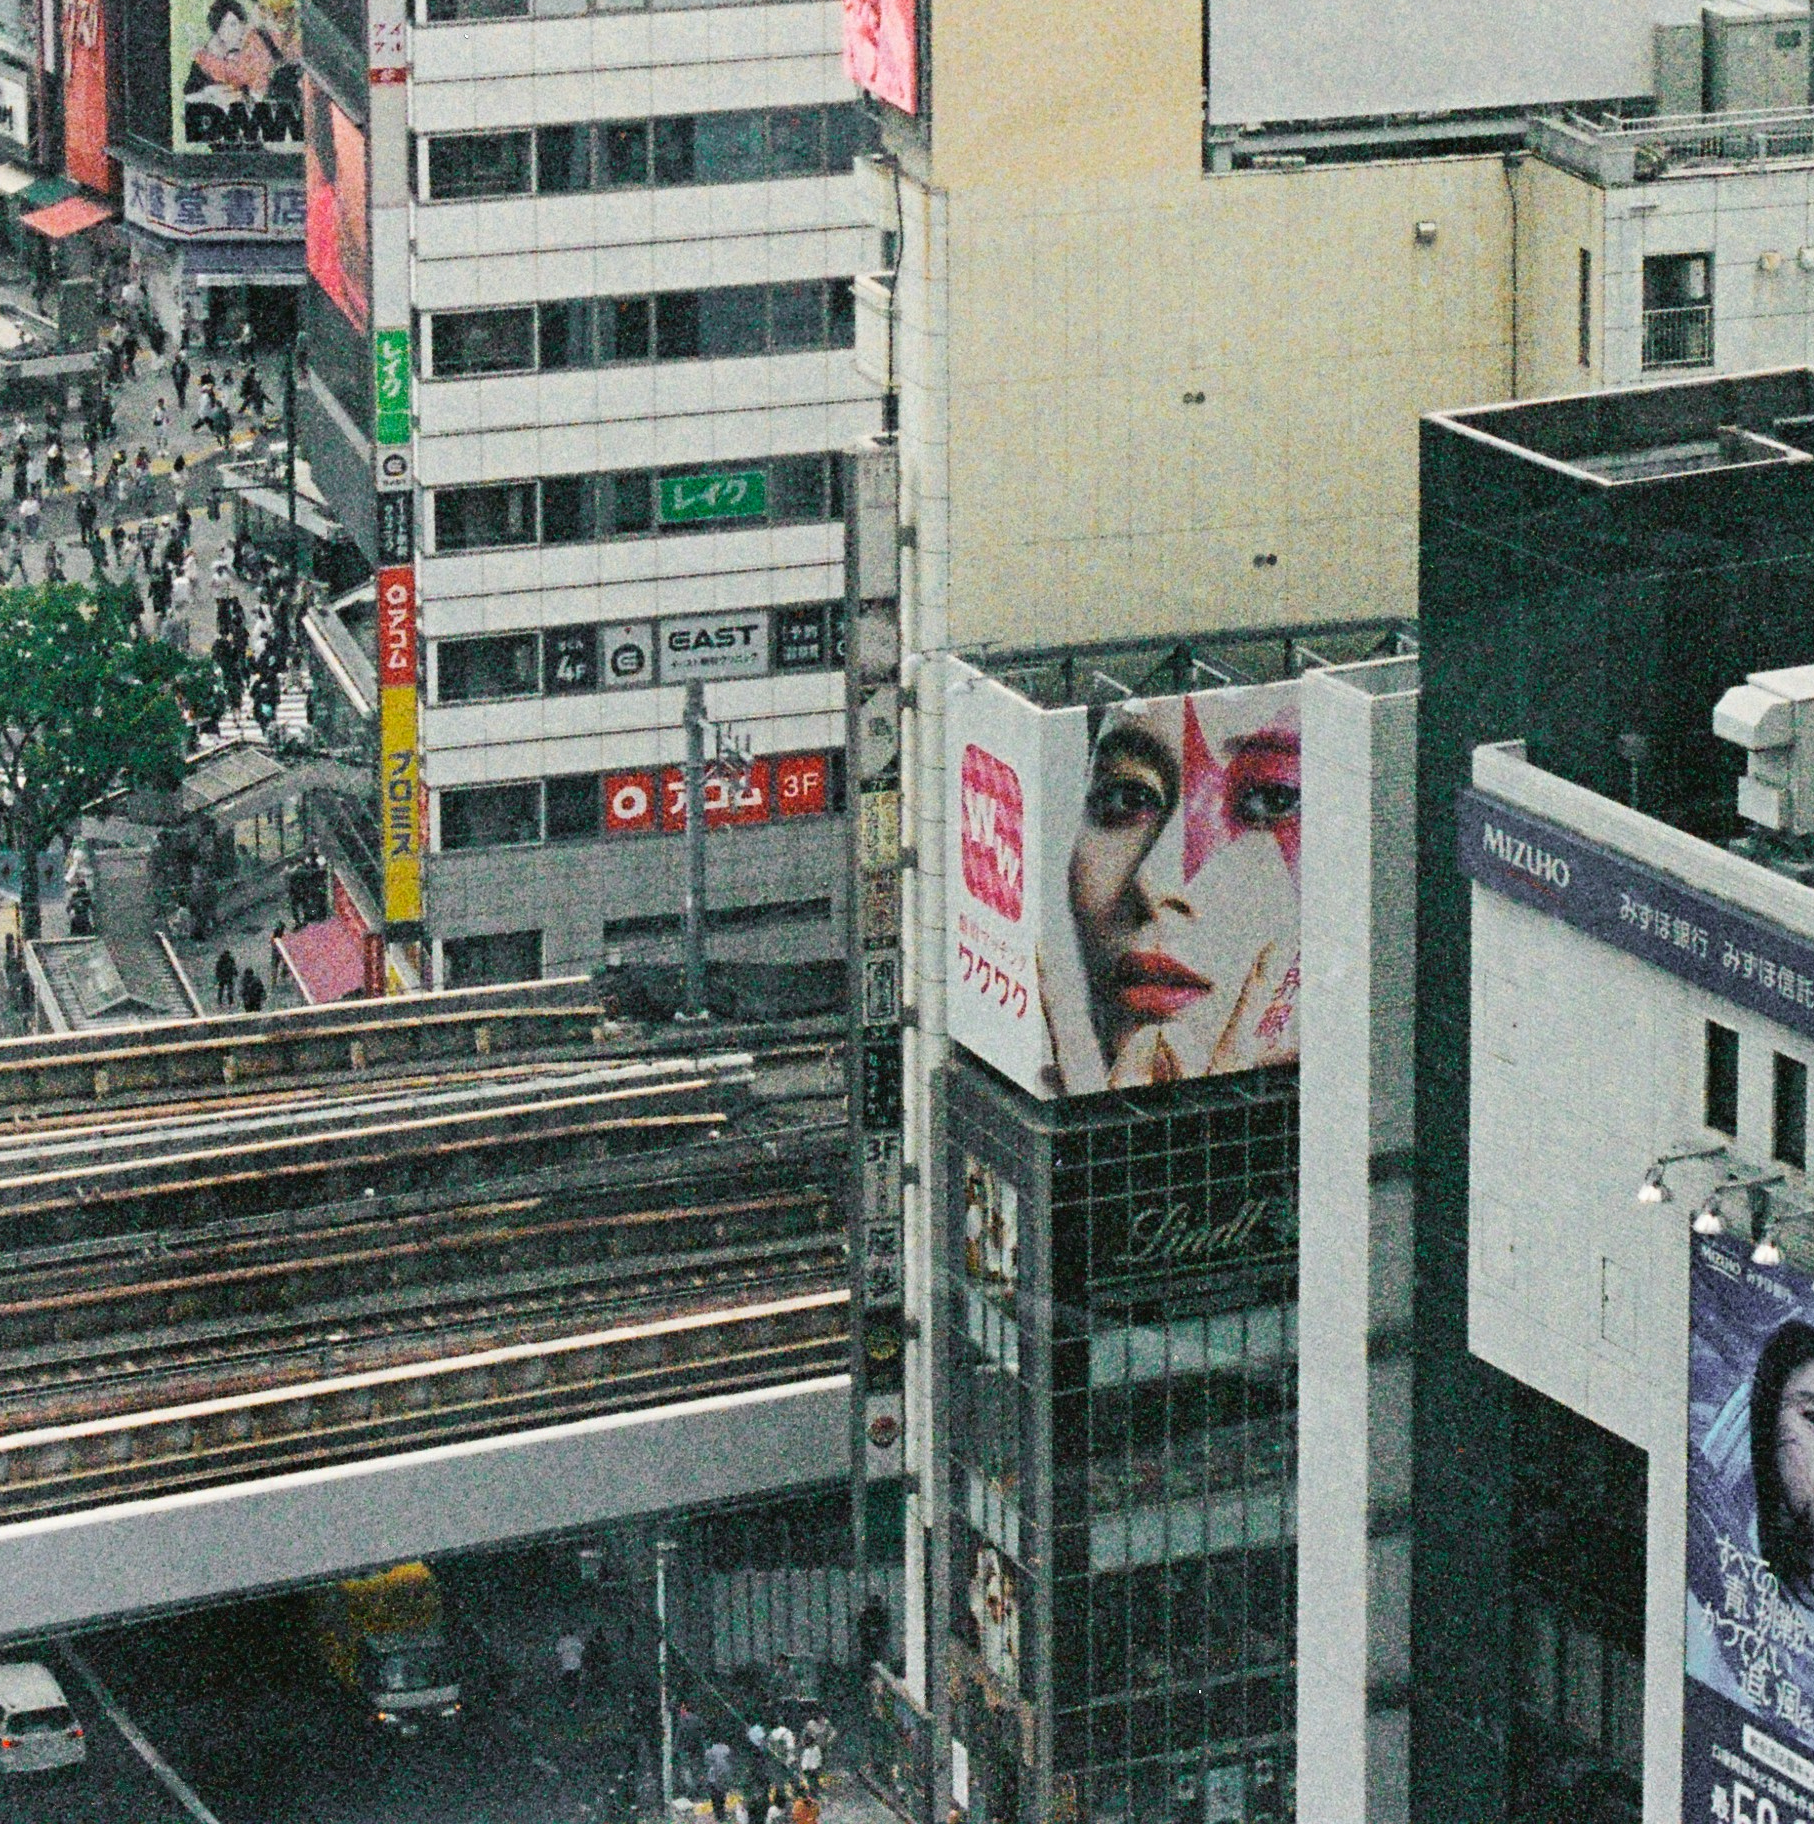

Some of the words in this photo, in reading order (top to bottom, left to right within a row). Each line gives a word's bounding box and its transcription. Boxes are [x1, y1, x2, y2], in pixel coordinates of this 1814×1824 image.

[672, 475, 750, 510] レイク
[386, 608, 407, 670] アコム
[668, 624, 759, 652] EAST
[555, 654, 586, 682] 4F
[388, 750, 413, 857] プロミス
[783, 771, 819, 801] 3F
[1483, 821, 1571, 890] MIZUHO
[1618, 892, 1710, 961] みずほ銀行
